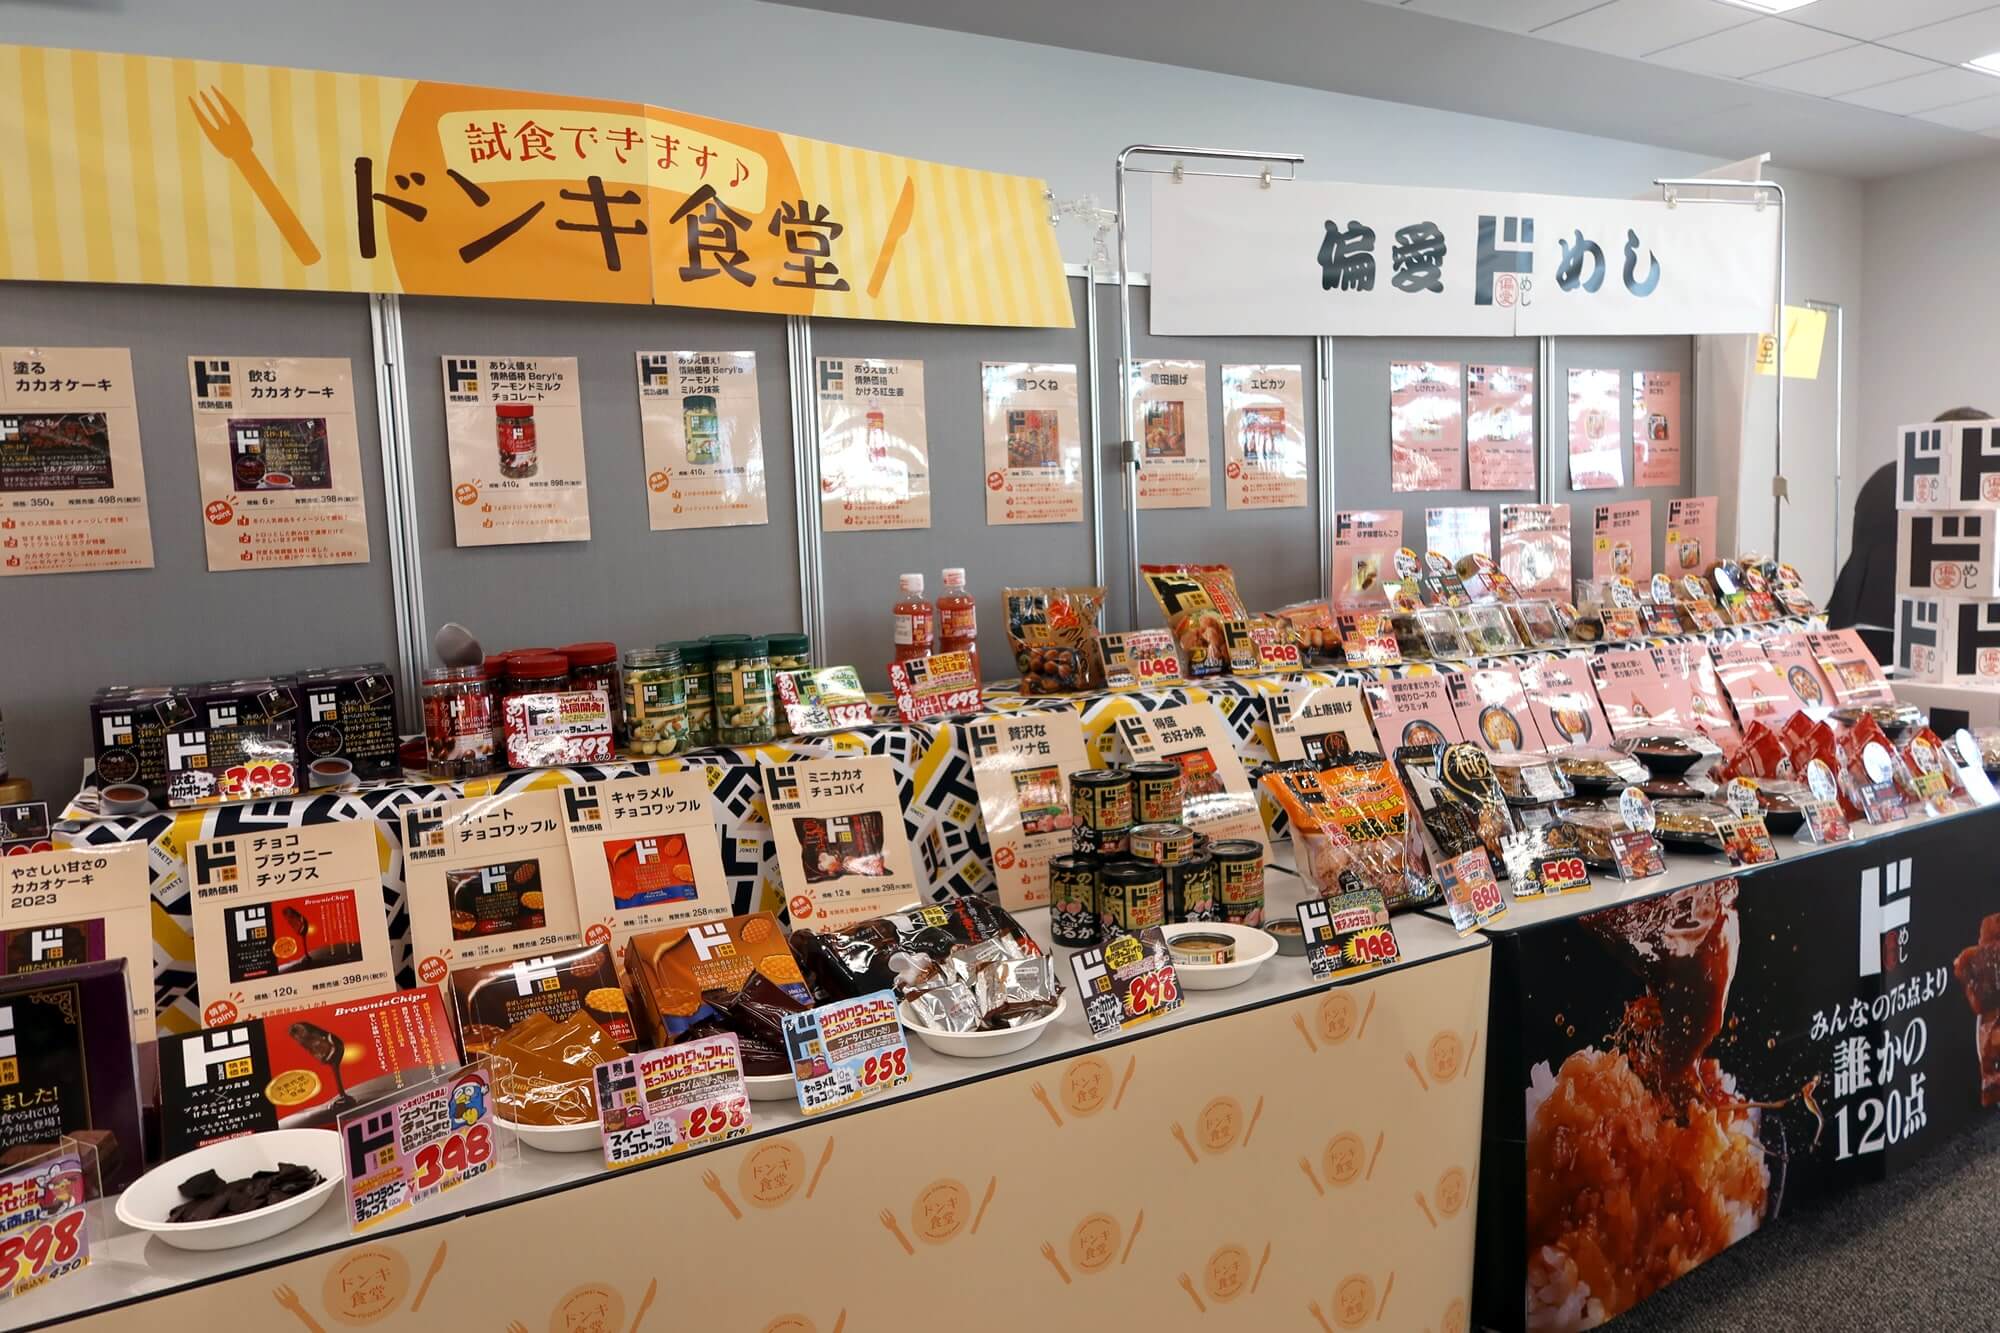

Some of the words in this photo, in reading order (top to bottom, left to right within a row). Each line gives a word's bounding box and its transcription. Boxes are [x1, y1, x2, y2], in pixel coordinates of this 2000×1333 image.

[354, 157, 850, 292] ドンキ食堂
[13, 361, 46, 374] 塗る
[249, 370, 277, 382] 飲む
[490, 372, 526, 381] 情熱価格
[16, 379, 112, 392] カカオケーキ
[490, 382, 561, 391] アーモンドミルク
[680, 376, 719, 384] アーモンド
[1251, 378, 1285, 390] エビカツ
[251, 386, 335, 399] カカオケーキ
[491, 393, 545, 401] チョコレート
[681, 385, 720, 394] ミルク抹茶
[1260, 645, 1298, 662] 598
[1139, 657, 1179, 678] 498
[947, 688, 980, 709] 498
[1302, 700, 1353, 718] 極上唐揚げ
[1152, 715, 1178, 729] 得盛
[1008, 724, 1047, 741] 贅沢な
[1161, 725, 1207, 744] お好み焼
[1011, 741, 1051, 755] ツナ缶
[225, 763, 295, 794] 398
[807, 768, 863, 783] ミニカカオ
[170, 784, 215, 799] カカオケーキ
[611, 786, 674, 803] キャラメル
[810, 783, 865, 798] チョコパイ
[613, 799, 701, 820] チョコワッフル
[459, 818, 557, 843] チョコワッフル
[570, 823, 603, 834] 情熱価格
[253, 834, 299, 852] チョコ
[255, 850, 333, 869] ブラウニー
[409, 847, 446, 861] 情熱価格
[11, 858, 108, 880] やさしい甘さの
[256, 866, 320, 888] チップス
[1541, 857, 1587, 884] 598
[11, 874, 94, 895] カカオケーキ
[197, 884, 239, 899] 情熱価格
[11, 893, 57, 909] 2023
[1471, 883, 1501, 914] 880
[420, 962, 440, 974] 情熱
[422, 965, 447, 982] Point
[1129, 966, 1177, 1016] 298
[208, 1003, 229, 1017] 情熱
[820, 999, 894, 1026] サクサクワッフルに
[1810, 966, 1949, 1042] みんなの75点より
[209, 1010, 237, 1028] Point
[640, 1046, 734, 1076] サクサクワッフルに
[863, 1047, 908, 1087] 258
[1832, 1016, 1928, 1100] 誰かの
[803, 1076, 837, 1094] キャラメル
[806, 1083, 855, 1107] チョコワッフル
[400, 1099, 447, 1123] スナックに
[687, 1096, 746, 1140] 258
[1833, 1072, 1928, 1162] 120点
[610, 1128, 652, 1147] スイート
[612, 1135, 674, 1160] チョコワッフル
[415, 1125, 493, 1190] 398
[355, 1180, 406, 1212] チョコブラウニー
[356, 1198, 388, 1223] チップス
